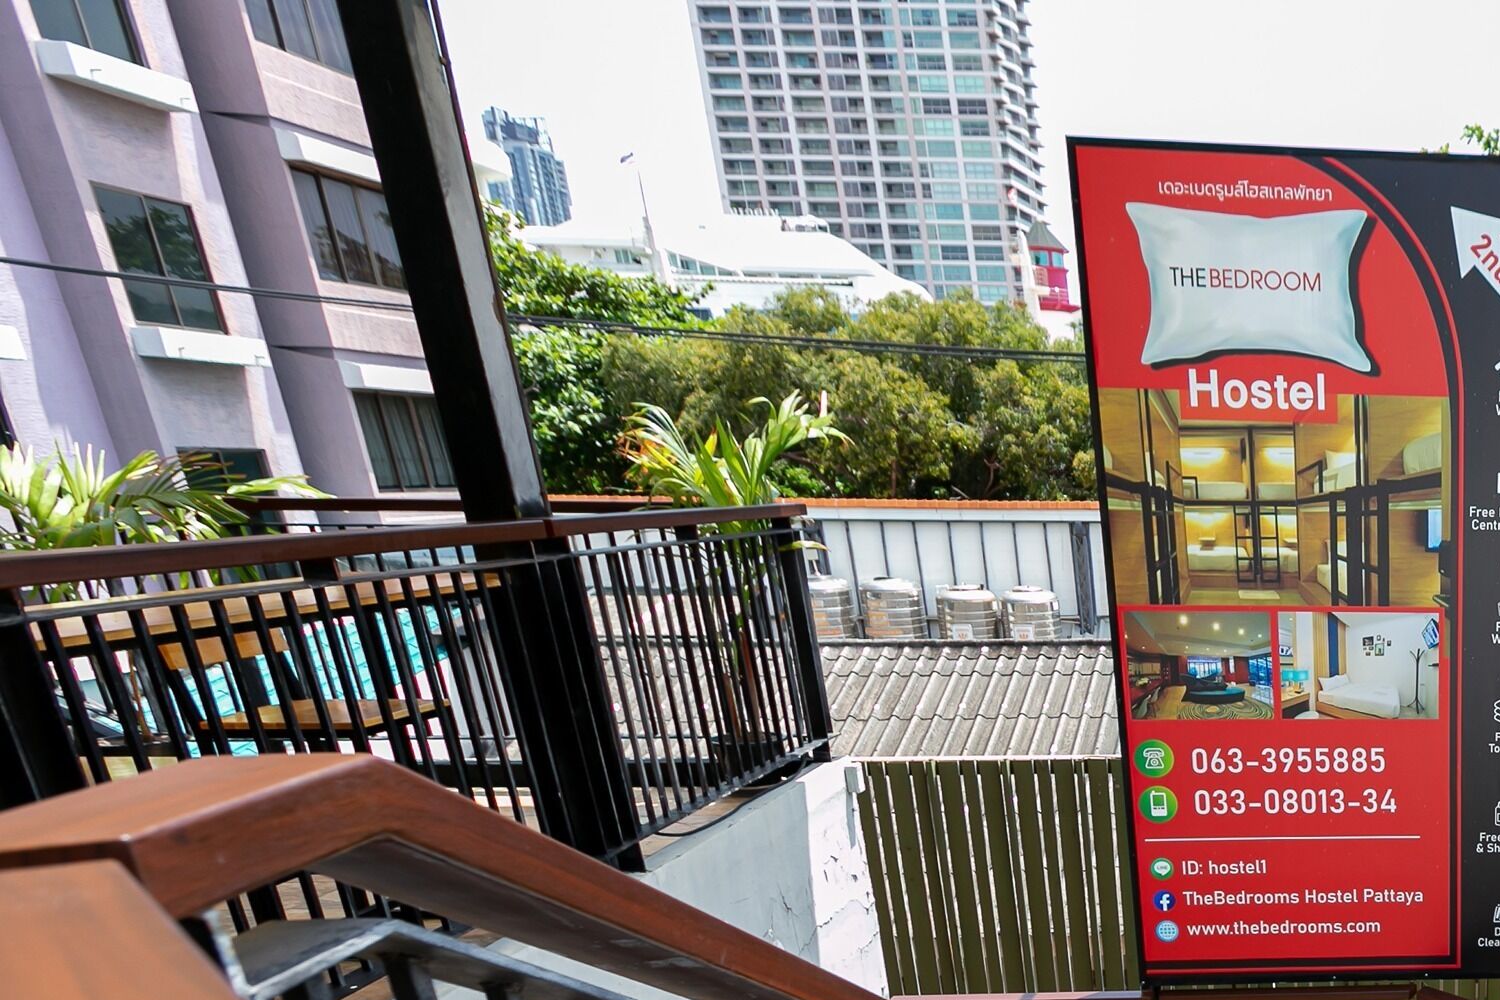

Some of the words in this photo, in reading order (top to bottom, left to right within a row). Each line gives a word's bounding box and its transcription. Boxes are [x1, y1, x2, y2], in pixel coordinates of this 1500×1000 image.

[1157, 179, 1333, 202] เดอะเบดรูมส์โฮสเทลพัทยา
[1188, 368, 1327, 411] Hostel
[1469, 506, 1495, 518] Free
[1191, 748, 1386, 773] 063-3955885
[1194, 789, 1397, 814] 033-08013-34
[1476, 843, 1484, 853] &
[1181, 860, 1203, 875] ID:
[1208, 859, 1267, 875] hostel1
[1183, 891, 1299, 906] TheBedrooms
[1304, 889, 1359, 905] Hostel
[1362, 888, 1425, 907] Pattaya
[1186, 919, 1381, 936] www.thebedrooms.com
